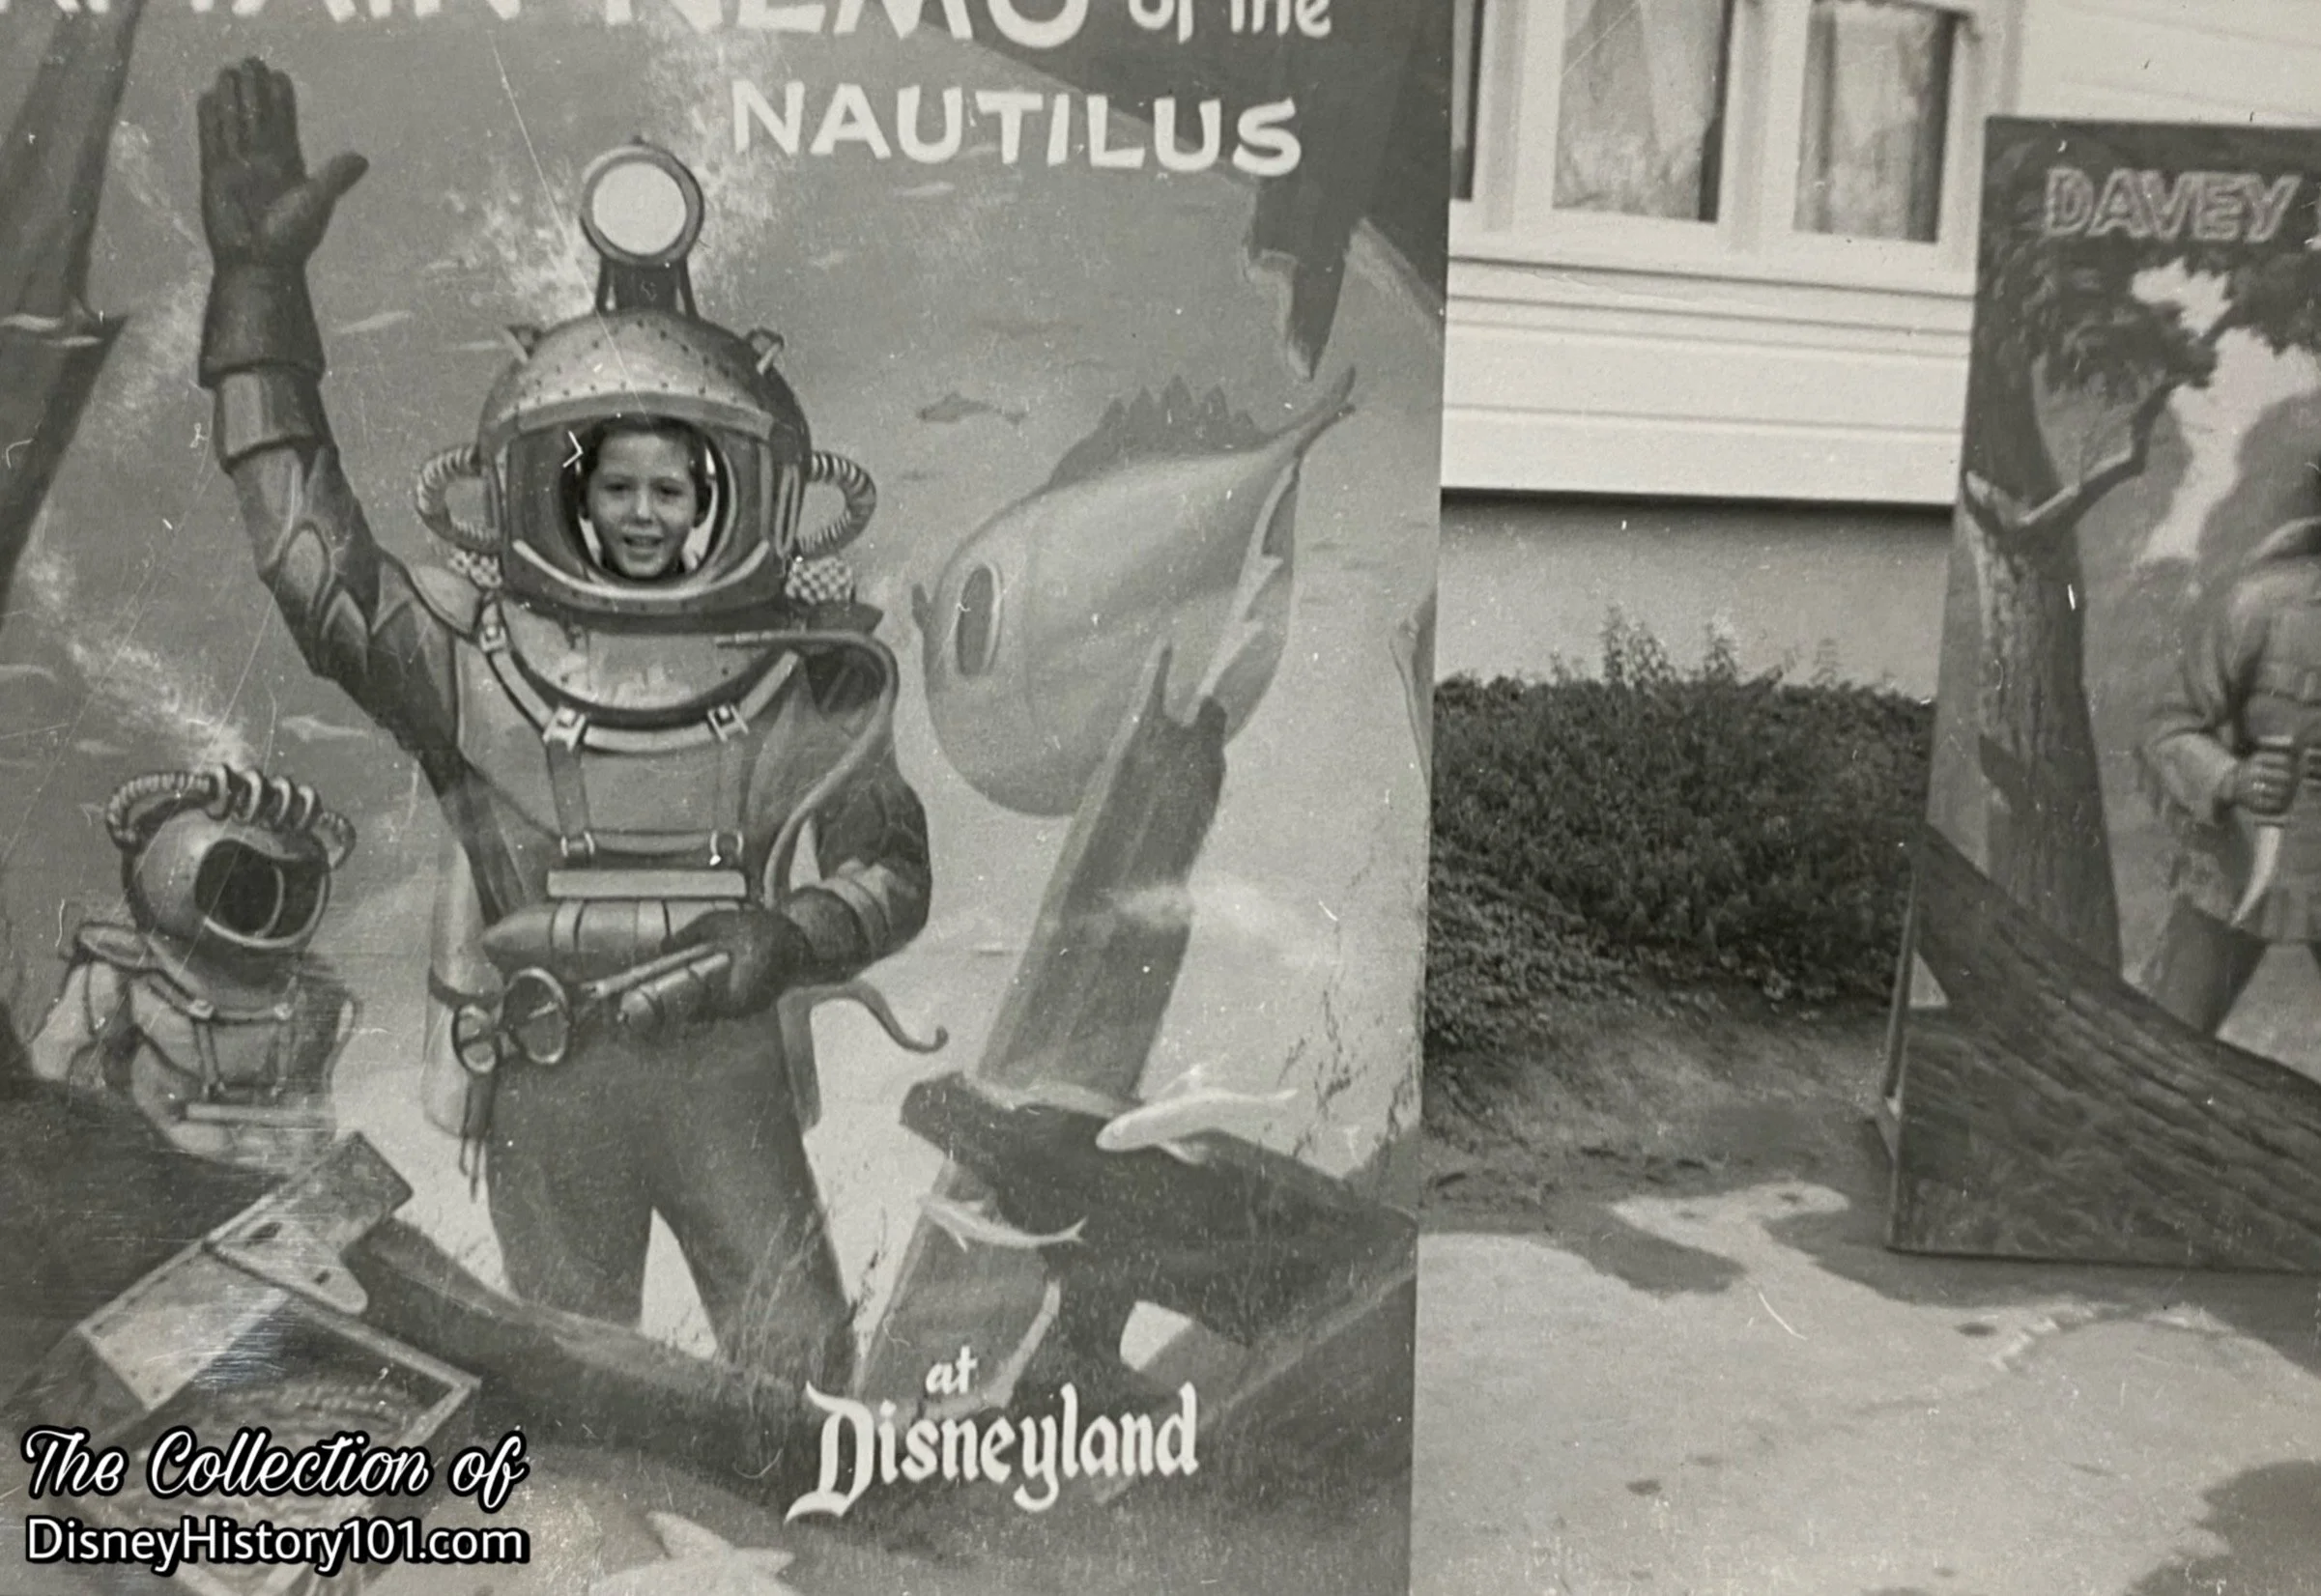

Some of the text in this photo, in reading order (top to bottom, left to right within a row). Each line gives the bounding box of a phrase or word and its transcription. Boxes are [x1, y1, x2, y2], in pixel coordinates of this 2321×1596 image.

[731, 77, 1302, 177] NAUTILUS
[2044, 165, 2304, 243] DAVEY
[924, 1345, 978, 1394] at
[784, 1380, 1200, 1525] Disneyland
